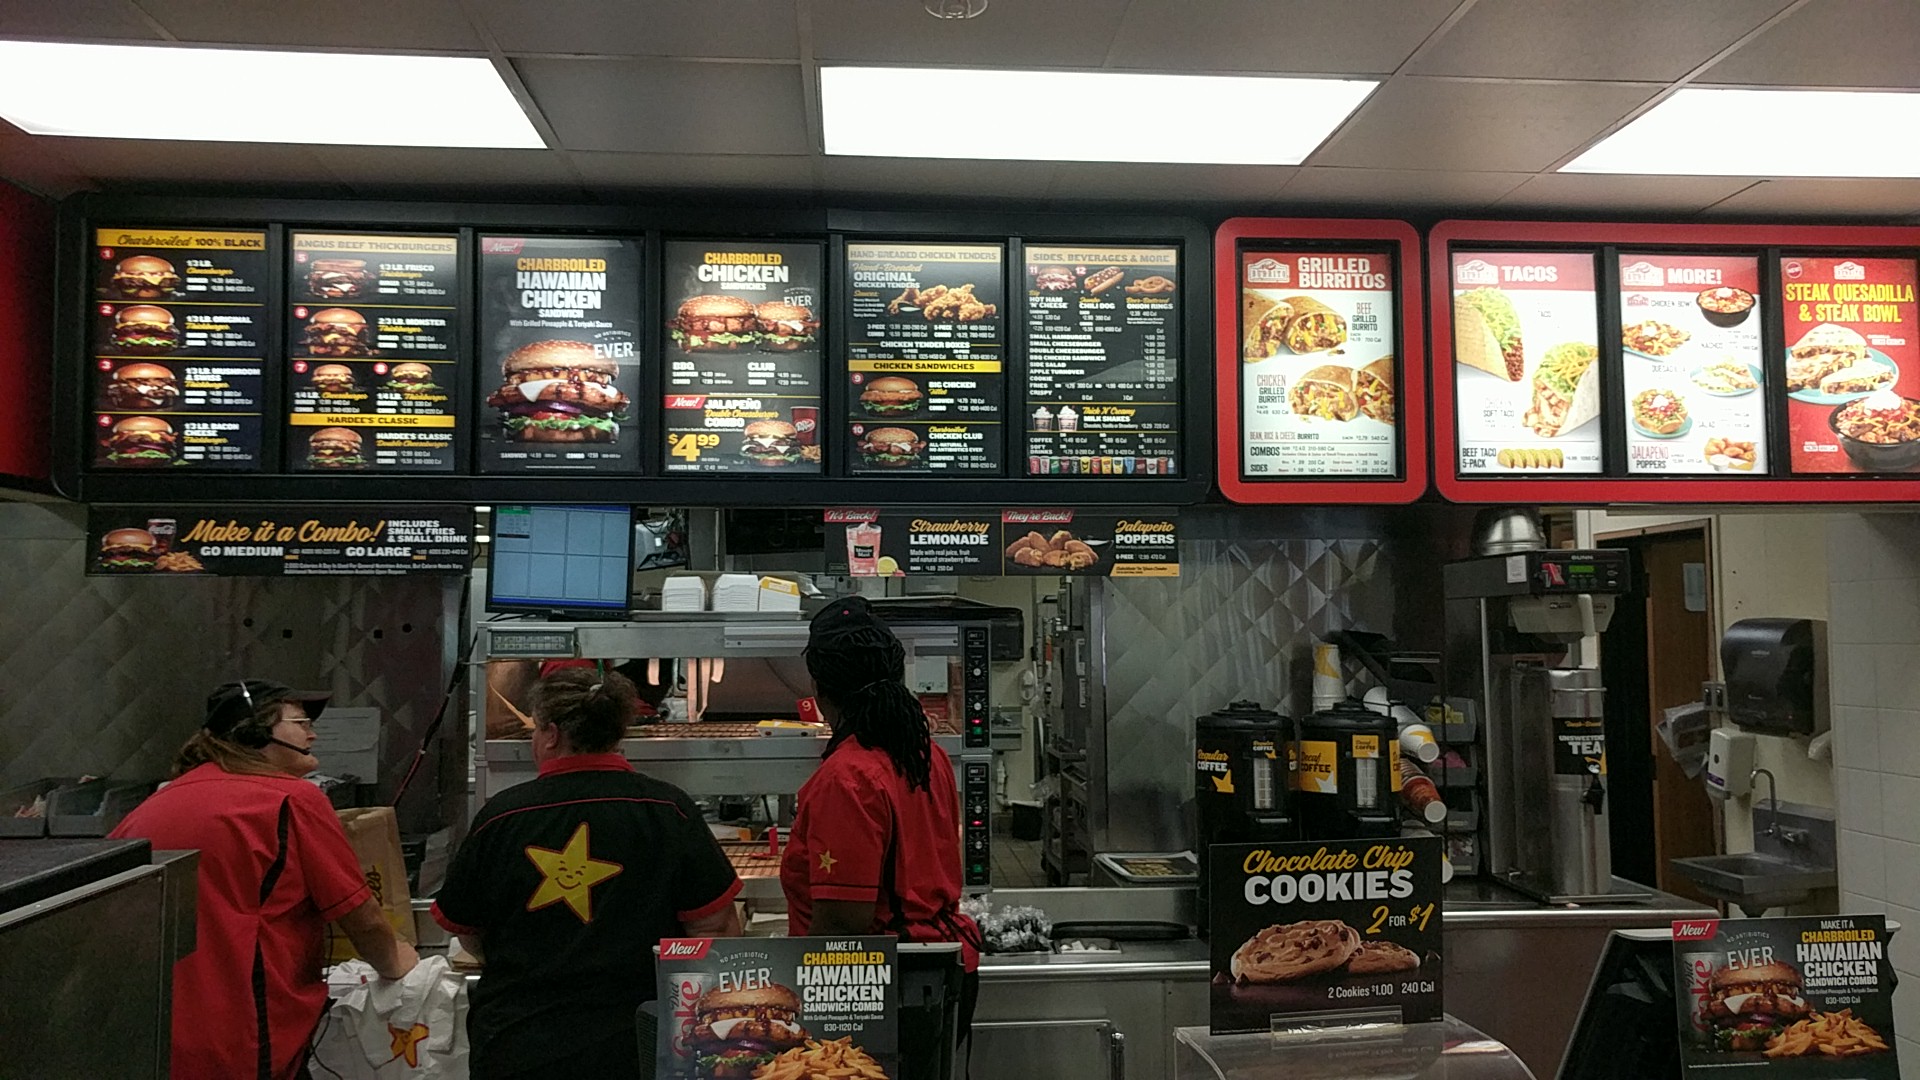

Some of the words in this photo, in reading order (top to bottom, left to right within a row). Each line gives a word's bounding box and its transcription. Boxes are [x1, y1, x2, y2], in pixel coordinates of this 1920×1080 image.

[117, 235, 191, 246] Charbroiled
[225, 239, 261, 247] BLACK
[296, 240, 334, 248] ANGUS
[338, 241, 364, 249] BEEF
[368, 242, 452, 251] THICKBURGERS
[704, 253, 782, 265] CHARBROILED
[1068, 254, 1128, 262] BEVERAGES
[517, 257, 606, 272] CHARBROILED
[1298, 257, 1370, 273] GRILLED
[698, 264, 789, 282] CHICKEN
[854, 272, 916, 281] ORIGINAL
[1502, 266, 1558, 282] TACOS
[1668, 268, 1722, 284] MORE!
[516, 271, 606, 290] HAWAIIAN
[1299, 273, 1386, 289] BURRITOS
[521, 290, 601, 309] CHICKEN
[1786, 283, 1830, 301] STEAK
[1833, 284, 1914, 304] QUESADILLA
[784, 295, 812, 307] EVER
[538, 309, 584, 318] SANDWICH
[1356, 302, 1372, 314] BEEF
[1799, 304, 1812, 322] &
[1815, 304, 1860, 322] STEAK
[1863, 305, 1902, 322] BOWL
[1352, 315, 1377, 323] GRILLED
[1352, 323, 1378, 331] BURRITO
[594, 342, 634, 359] EVER
[748, 362, 776, 371] CLUB
[1257, 374, 1286, 387] CHICKEN
[1259, 387, 1284, 395] GRILLED
[672, 397, 699, 406] New!
[705, 398, 761, 410] JALAPEÑO
[1250, 446, 1280, 457] COMBOS
[1462, 448, 1478, 457] BEEF
[1480, 448, 1497, 457] TACO
[1250, 464, 1268, 472] SIDES
[1462, 458, 1486, 468] 5-PACK
[1636, 461, 1666, 469] POPPERS
[1007, 511, 1041, 522] They're
[1042, 511, 1071, 521] Back!
[388, 520, 440, 528] INCLUDES
[909, 519, 990, 535] Strawberry
[1115, 520, 1175, 534] Jalapeño
[180, 520, 251, 543] Make
[254, 521, 275, 542] it
[276, 525, 296, 542] a
[298, 520, 385, 542] Combo!
[910, 535, 989, 545] LEMONADE
[1115, 534, 1175, 544] POPPERS
[200, 546, 221, 556] GO
[224, 546, 283, 556] MEDIUM
[346, 547, 365, 556] GO
[367, 547, 411, 556] LARGE
[945, 549, 959, 557] juice,
[802, 701, 811, 711] 9
[1568, 741, 1602, 754] TEA
[1198, 749, 1229, 761] Regular
[1301, 752, 1321, 762] Decaf
[1197, 761, 1227, 771] COFFEE
[1243, 847, 1359, 873] Chocolate
[1363, 845, 1414, 871] Chip
[1244, 870, 1414, 905] COOKIES
[1366, 905, 1389, 934] 2
[1389, 916, 1406, 927] FOR
[1409, 903, 1435, 931] $1
[1821, 920, 1840, 929] MAKE
[1841, 920, 1848, 928] IT
[1849, 920, 1854, 928] A
[1677, 923, 1710, 936] New!
[1802, 930, 1875, 943] CHARBROILED
[664, 941, 703, 955] New!
[826, 941, 847, 951] MAKE
[849, 942, 856, 950] IT
[857, 941, 863, 951] A
[1796, 942, 1882, 962] HAWAIIAN
[730, 952, 768, 960] ANTIBIOTICS
[804, 952, 884, 965] CHARBROILED
[1727, 946, 1775, 971] EVER
[797, 965, 891, 985] HAWAIIAN
[1804, 961, 1877, 977] CHICKEN
[719, 968, 772, 993] EVER
[1806, 977, 1847, 986] SANDWICH
[1849, 976, 1877, 985] COMBO
[803, 986, 884, 1002] CHICKEN
[1328, 987, 1334, 998] 2
[1336, 986, 1370, 997] Cookies
[1372, 984, 1393, 995] $1.00
[1401, 983, 1418, 994] 240
[1421, 981, 1434, 993] Cal
[804, 1002, 850, 1012] SANDWICH
[852, 1002, 884, 1011] COMBO
[853, 1023, 863, 1031] Cal
